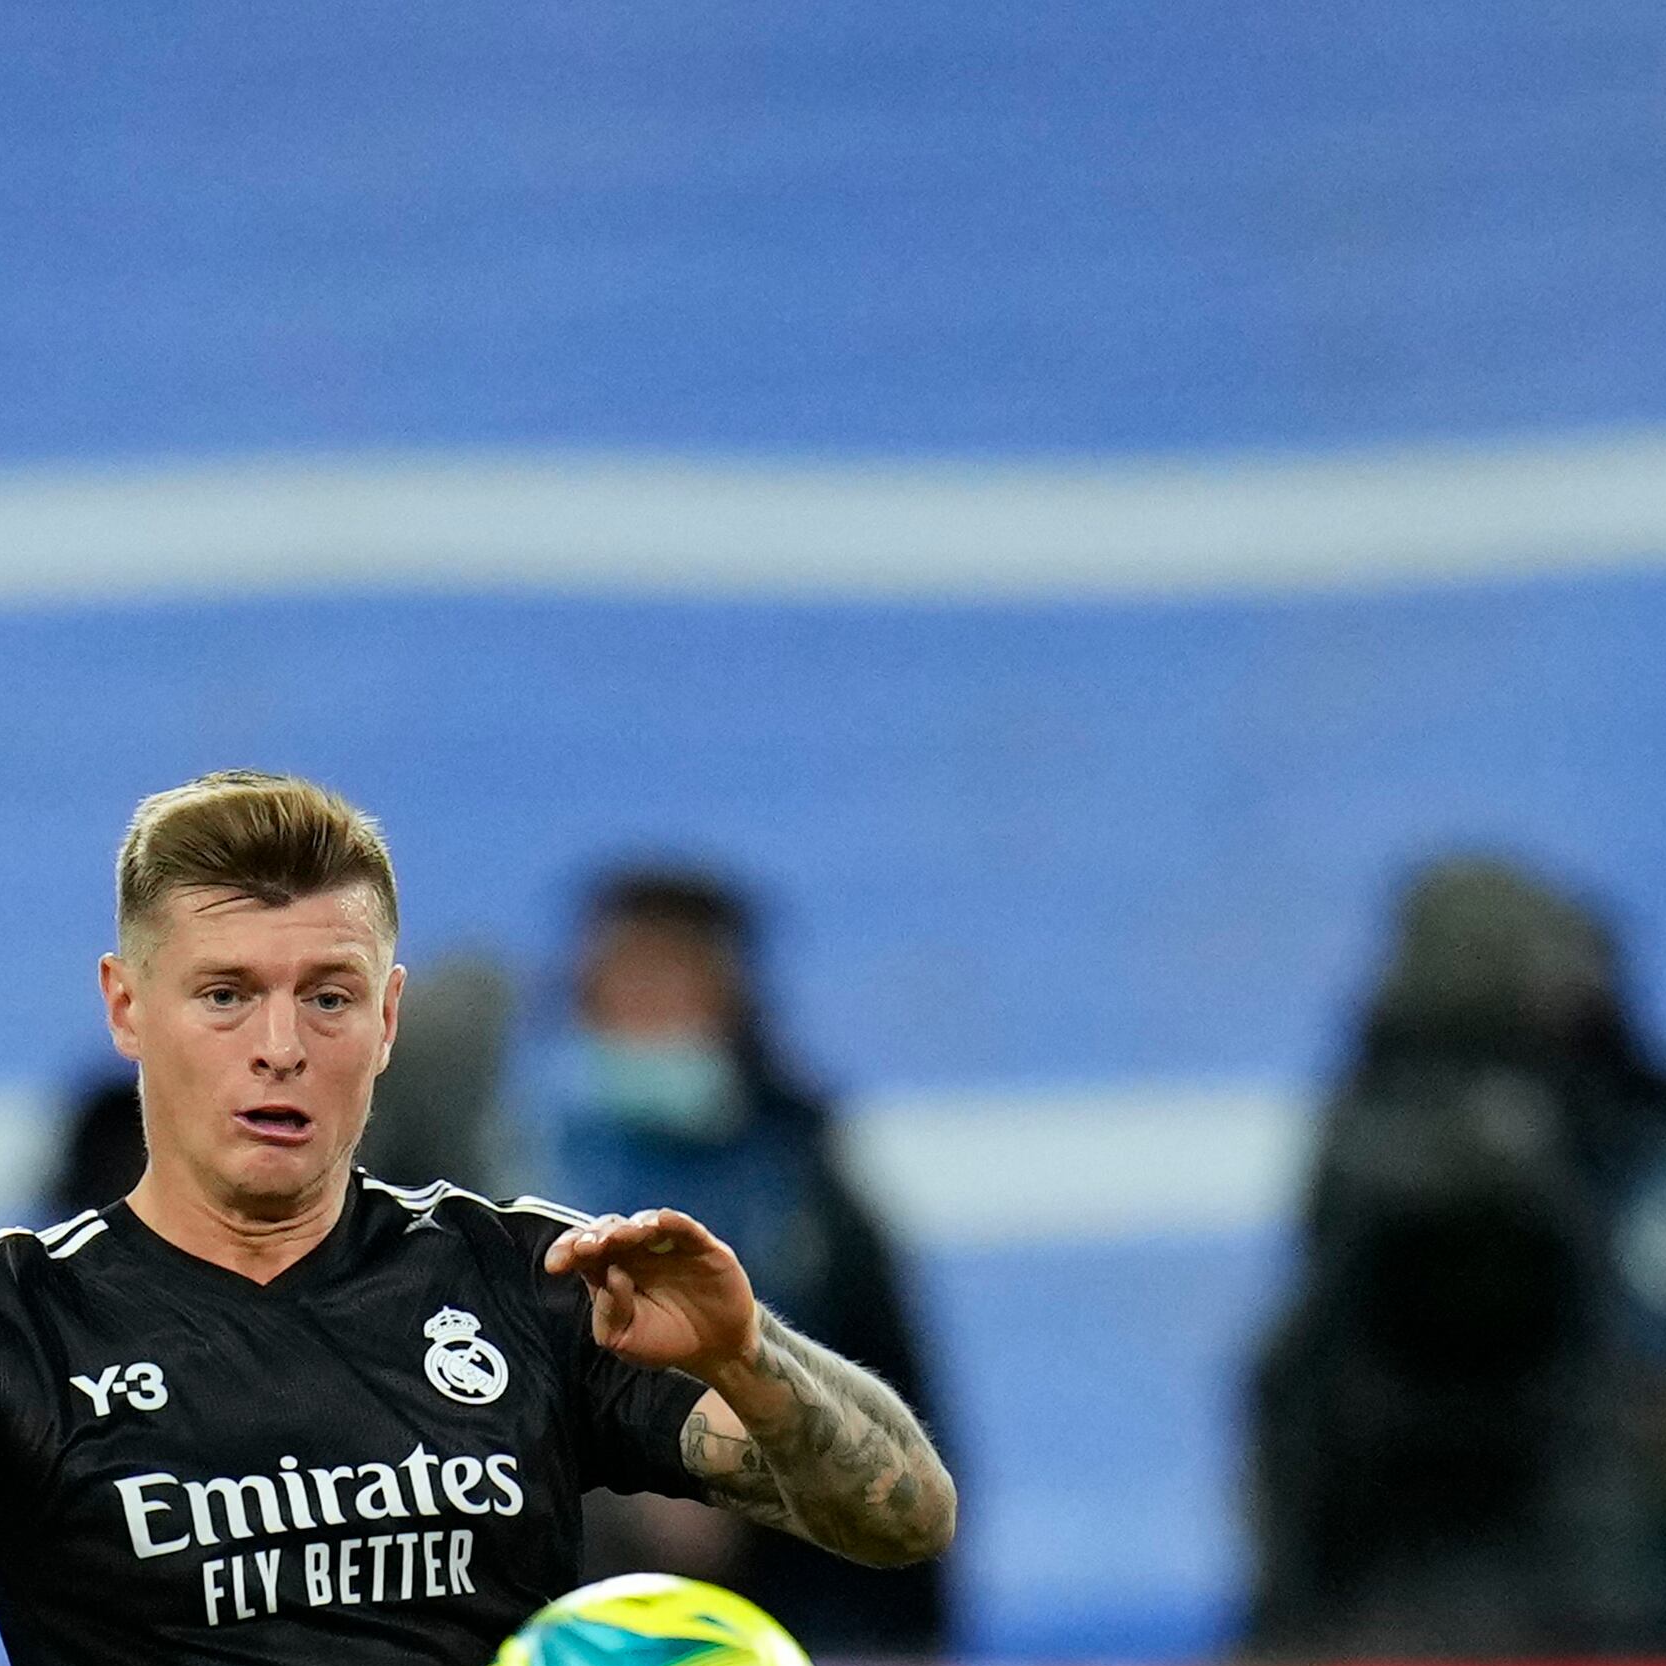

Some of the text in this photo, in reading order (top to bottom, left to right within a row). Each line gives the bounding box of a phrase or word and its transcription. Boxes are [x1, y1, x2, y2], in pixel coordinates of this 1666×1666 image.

[69, 1362, 169, 1417] Y-3
[113, 1442, 524, 1559] Emirates
[201, 1529, 476, 1626] FLY BETTER
